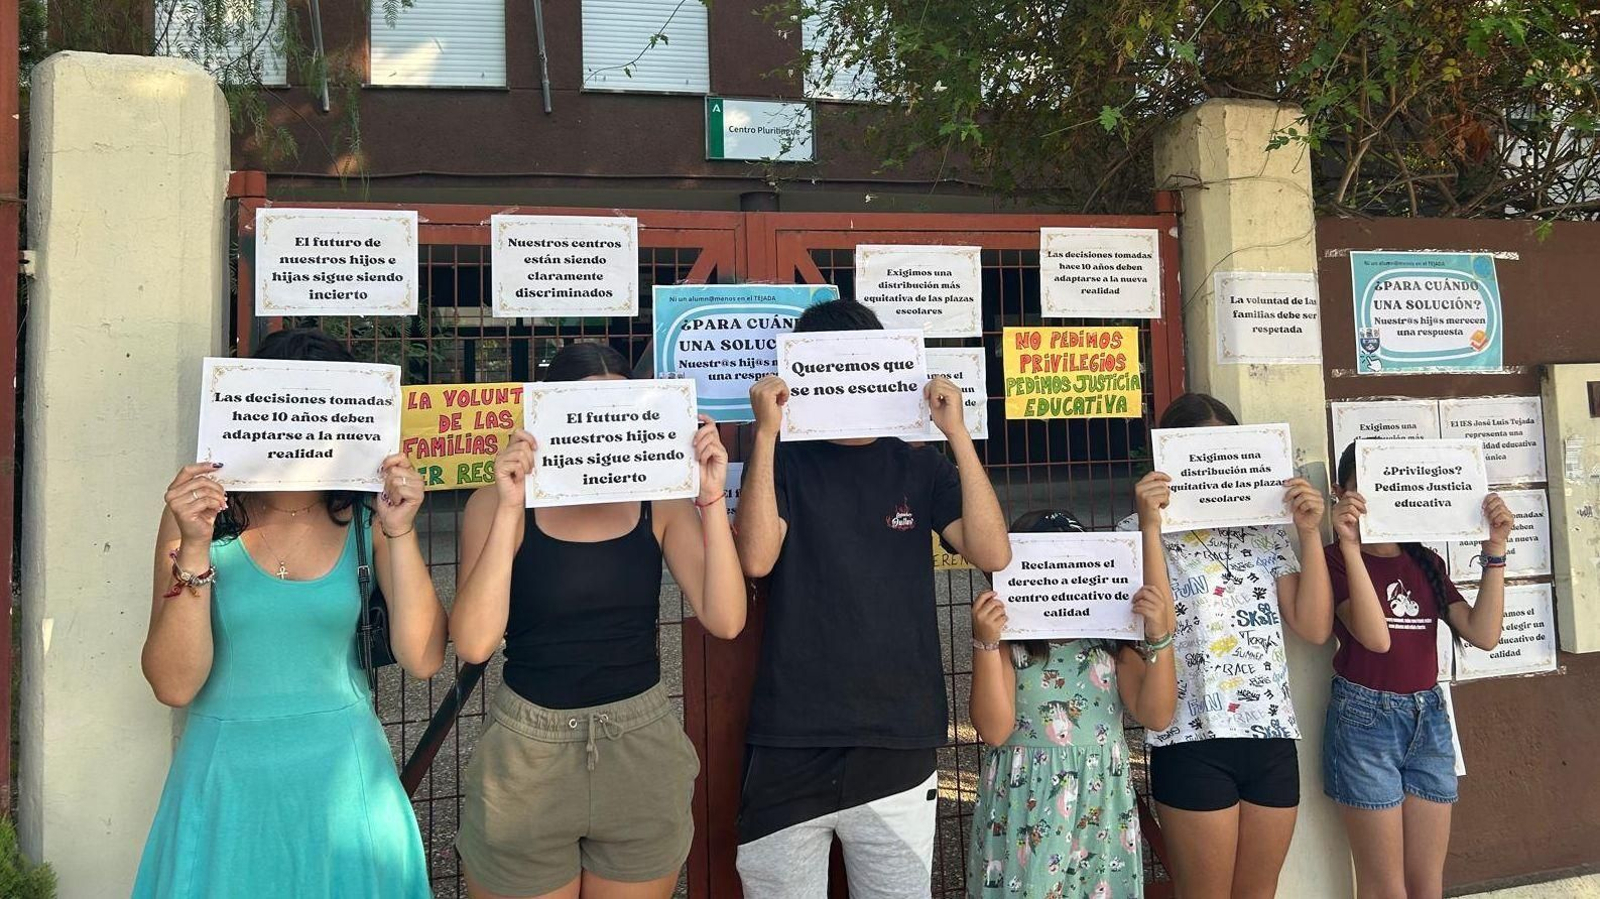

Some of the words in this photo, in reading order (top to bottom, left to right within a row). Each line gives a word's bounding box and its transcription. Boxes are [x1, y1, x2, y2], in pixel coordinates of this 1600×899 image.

[296, 238, 309, 246] El
[313, 237, 361, 247] futuro
[365, 238, 381, 247] de
[508, 239, 569, 247] Nuestros
[572, 240, 621, 248] centros
[280, 256, 346, 264] nuestros
[350, 255, 385, 266] hijos
[524, 254, 560, 263] están
[564, 255, 606, 264] siendo
[272, 272, 310, 283] hijas
[313, 272, 353, 283] sigue
[357, 272, 403, 281] siendo
[528, 272, 603, 280] claramente
[887, 269, 932, 277] Exigimos
[1054, 275, 1101, 283] adaptarse
[1374, 281, 1422, 291] ¿PARA
[1425, 277, 1479, 291] CUÁNDO
[309, 290, 367, 299] incierto
[516, 288, 612, 297] discriminados
[864, 294, 913, 303] equitativa
[945, 295, 973, 303] plazas
[1374, 300, 1402, 310] UNA
[1405, 296, 1481, 310] SOLUCIÓN?
[1233, 310, 1275, 318] familias
[1277, 311, 1300, 319] debe
[681, 318, 742, 331] ¿PARA
[1374, 316, 1419, 325] Nuestr@s
[1420, 316, 1444, 327] hij@s
[1446, 317, 1486, 325] merecen
[1253, 326, 1302, 335] respetada
[1417, 328, 1463, 338] respuesta
[679, 339, 716, 352] UNA
[721, 338, 777, 351] SOLUC
[1015, 331, 1041, 350] NO
[679, 360, 737, 368] Nuestr@s
[739, 358, 770, 368] hij@s
[792, 362, 880, 377] Queremos
[884, 361, 914, 373] que
[791, 387, 809, 396] se
[814, 386, 844, 395] nos
[848, 381, 917, 394] escuche
[215, 393, 242, 402] Las
[246, 393, 326, 404] decisiones
[330, 396, 392, 405] tomadas
[408, 392, 432, 409] LA
[443, 387, 523, 407] VOLUNT
[233, 411, 268, 421] hace
[273, 412, 287, 421] 10
[291, 412, 327, 422] años
[331, 413, 374, 423] deben
[439, 412, 462, 433] DE
[474, 410, 514, 429] LAS
[567, 413, 582, 423] El
[587, 412, 638, 423] futuro
[642, 410, 660, 420] de
[1473, 419, 1491, 427] José
[1511, 418, 1535, 426] Tejada
[1360, 423, 1399, 433] Exigimos
[223, 430, 302, 442] adaptarse
[319, 431, 332, 440] la
[551, 434, 622, 445] nuestros
[627, 430, 664, 443] hijos
[1465, 430, 1508, 438] representa
[1502, 440, 1536, 448] educativa
[268, 449, 332, 458] realidad
[1190, 453, 1238, 463] Exigimos
[543, 455, 583, 468] hijas
[587, 453, 630, 466] sigue
[634, 450, 684, 462] siendo
[1181, 466, 1247, 476] distribución
[1250, 464, 1271, 473] más
[1384, 466, 1462, 477] ¿Privilegios?
[583, 473, 646, 484] incierto
[1375, 483, 1424, 491] Pedimos
[1427, 482, 1472, 491] Justicia
[1200, 495, 1250, 503] escolares
[1395, 498, 1451, 507] educativa
[1022, 561, 1100, 569] Reclamamos
[1104, 560, 1114, 568] el
[1008, 577, 1058, 586] derecho
[1071, 575, 1108, 586] elegir
[1052, 591, 1112, 601] educativo
[1115, 592, 1129, 600] de
[1044, 608, 1089, 616] calidad
[1506, 622, 1532, 632] elegir
[1490, 649, 1521, 658] calidad
